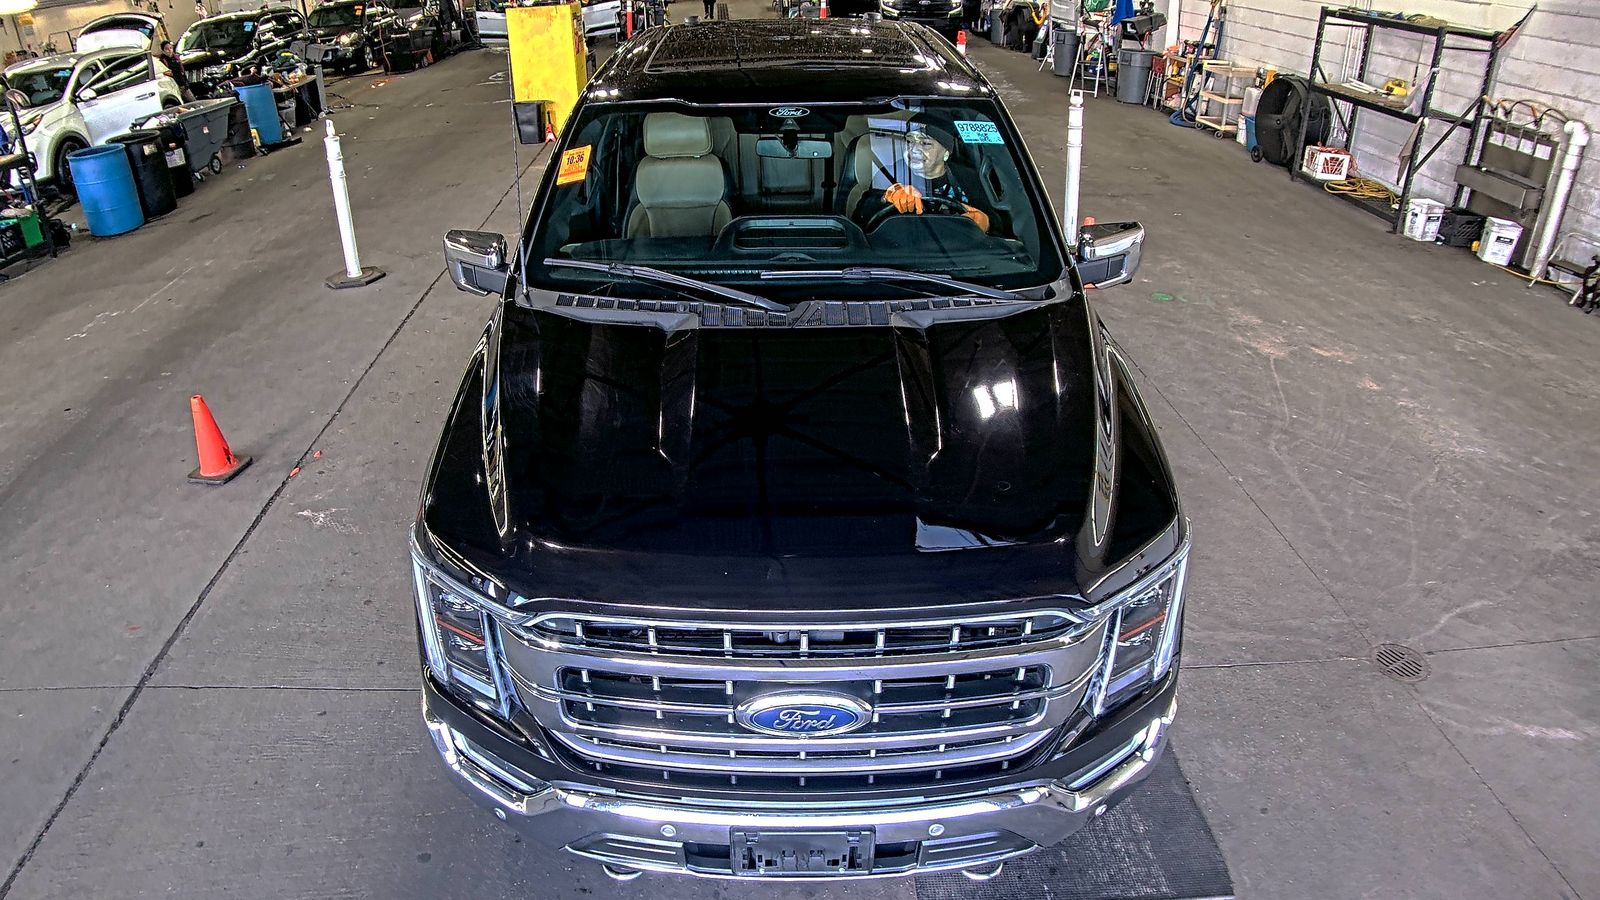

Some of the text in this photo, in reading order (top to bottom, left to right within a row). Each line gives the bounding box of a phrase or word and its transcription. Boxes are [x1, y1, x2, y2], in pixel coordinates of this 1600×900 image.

[776, 108, 803, 116] Ford
[957, 122, 998, 133] 9788825
[566, 153, 585, 166] 10:36
[773, 709, 836, 730] Ford
